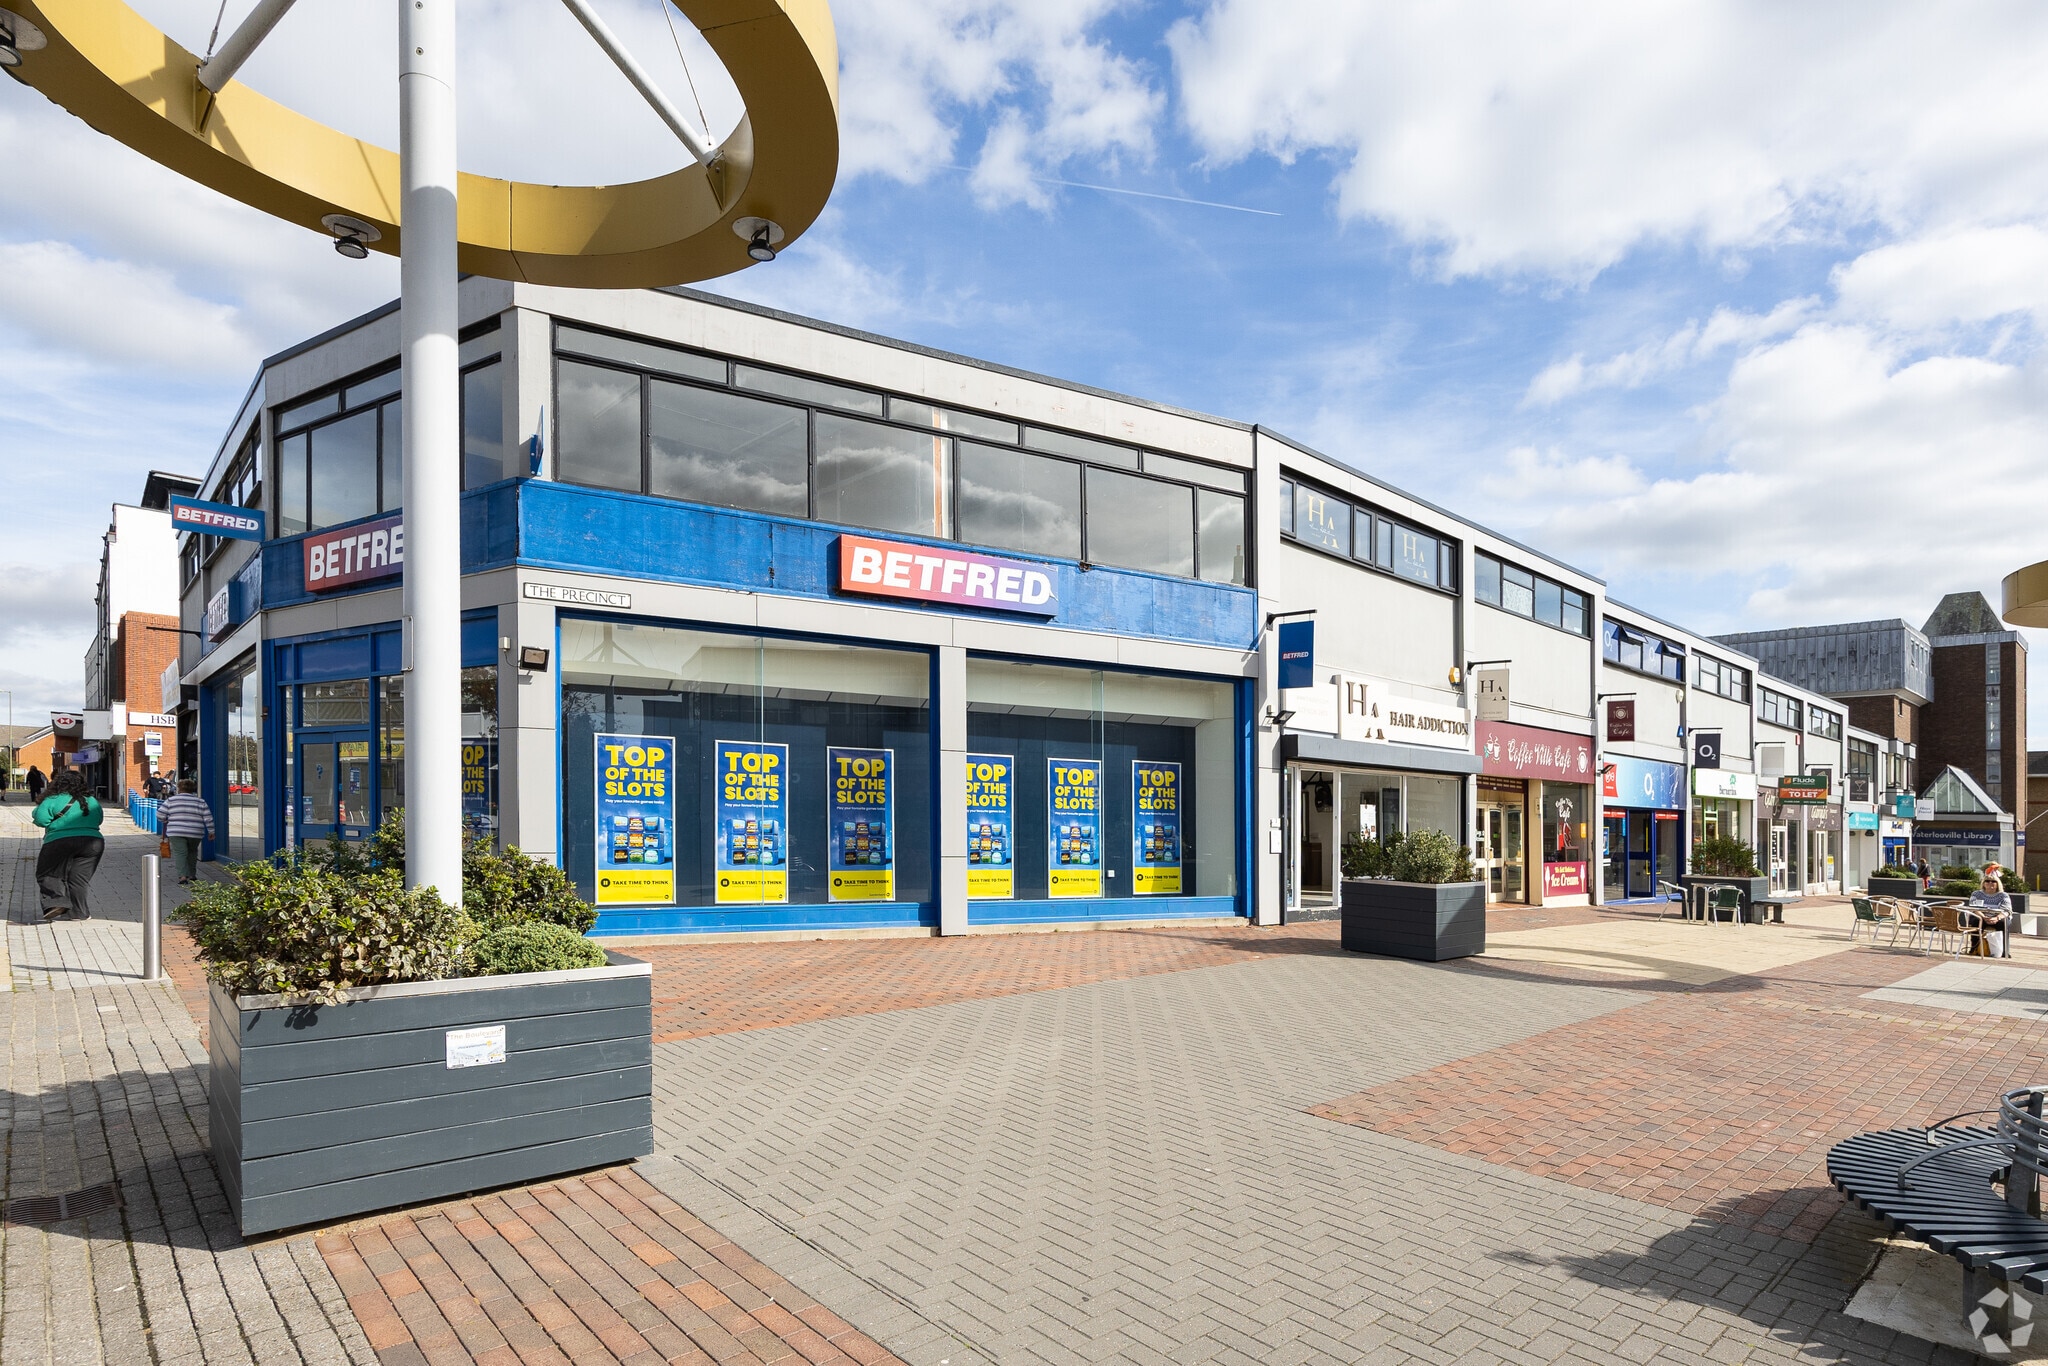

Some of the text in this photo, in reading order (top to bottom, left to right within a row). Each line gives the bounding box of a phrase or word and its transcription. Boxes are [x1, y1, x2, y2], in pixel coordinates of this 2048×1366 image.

[177, 507, 259, 531] BETFRED
[310, 525, 403, 581] BETFRE
[850, 547, 1051, 605] BETFRED
[530, 585, 626, 605] THE PRECINCT
[1282, 651, 1309, 660] BETFRED
[151, 715, 175, 725] HSB
[1390, 710, 1469, 736] HAIR ADDICTION
[462, 746, 484, 765] OP
[605, 744, 665, 768] TOP
[1508, 738, 1533, 770] Coffee
[1534, 743, 1552, 767] Ville
[724, 752, 779, 773] TOP
[836, 757, 886, 777] TOP
[466, 767, 484, 779] THE
[605, 767, 665, 782] OF THE
[725, 773, 779, 787] OF THE
[966, 763, 1006, 782] TOP
[1055, 767, 1095, 786] TOP
[1139, 769, 1175, 787] TOP
[462, 780, 485, 794] OTS
[605, 781, 665, 797] SLOTS
[836, 778, 885, 790] OF THE
[966, 782, 1006, 795] OF THE
[1055, 786, 1094, 797] OF THE
[725, 786, 779, 802] SLOTS
[836, 790, 886, 804] SLOTS
[1139, 787, 1175, 798] OF THE
[966, 794, 1006, 807] SLOTS
[1055, 798, 1095, 810] SLOTS
[1139, 798, 1176, 810] SLOTS
[1551, 873, 1579, 887] Ice Cream
